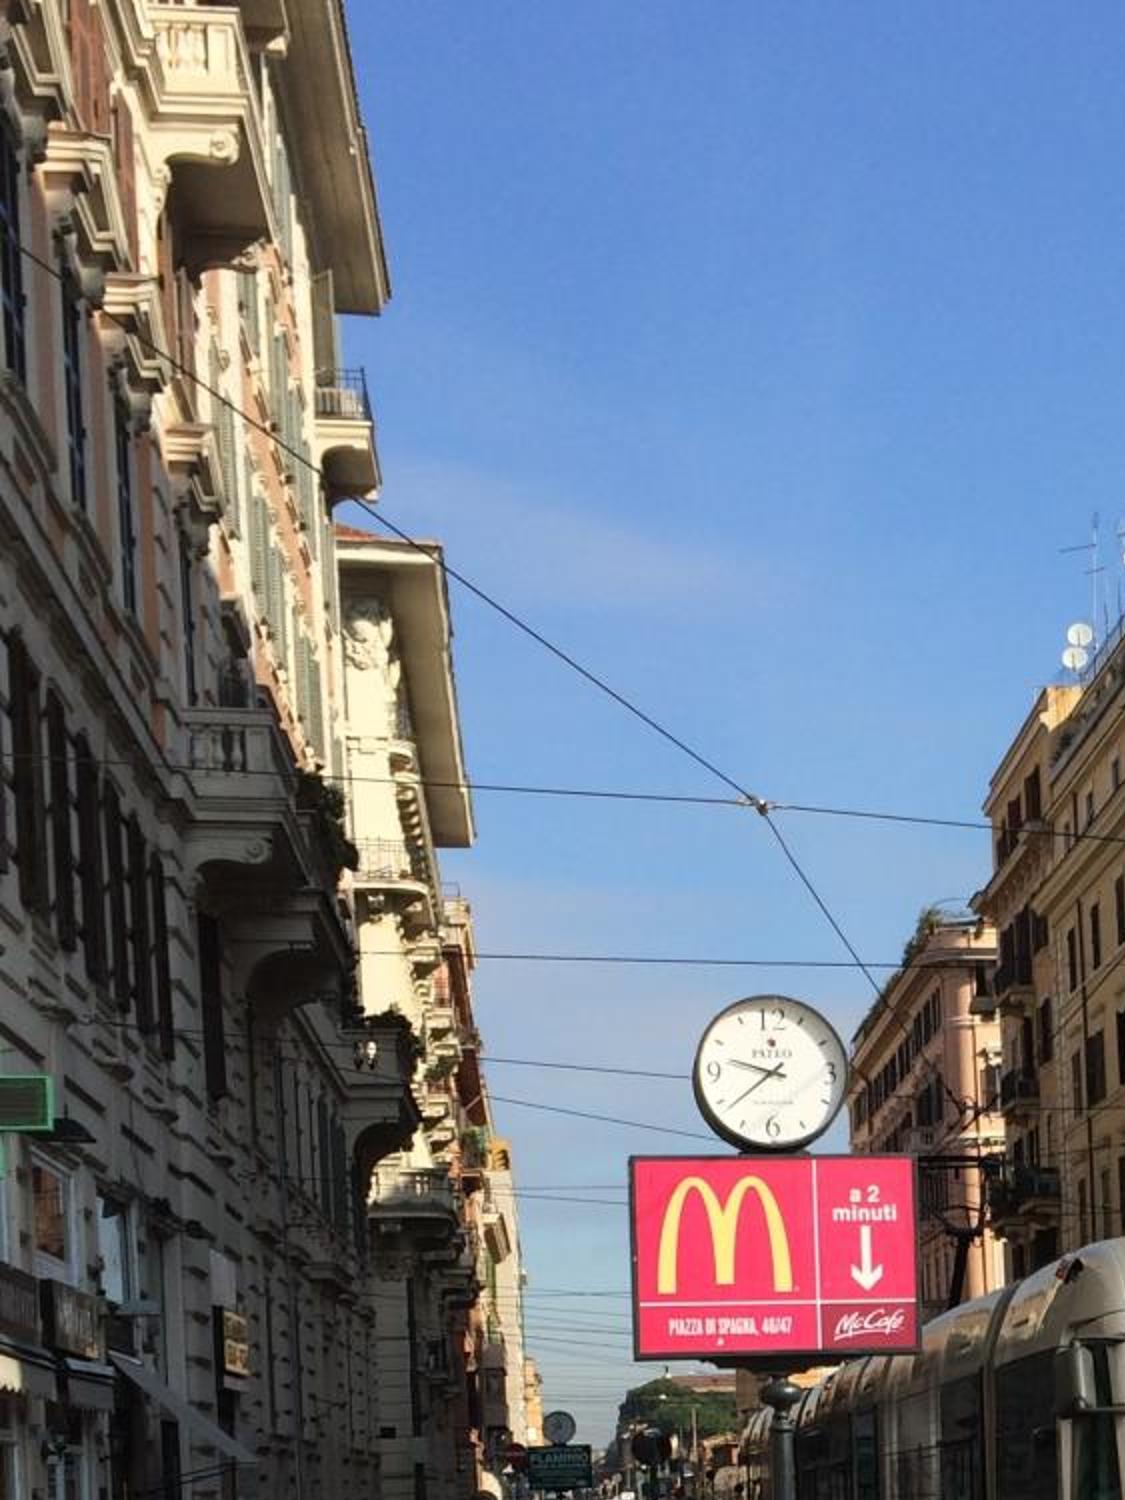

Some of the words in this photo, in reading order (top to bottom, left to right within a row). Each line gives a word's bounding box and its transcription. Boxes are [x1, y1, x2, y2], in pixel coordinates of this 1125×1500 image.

[761, 1008, 786, 1031] 12
[706, 1061, 722, 1083] 9
[826, 1062, 837, 1085] 3
[765, 1115, 781, 1138] 6
[848, 1188, 862, 1203] a
[867, 1184, 880, 1203] 2
[832, 1204, 897, 1222] minuti
[668, 1317, 703, 1336] PIAZZA
[705, 1317, 716, 1335] DI
